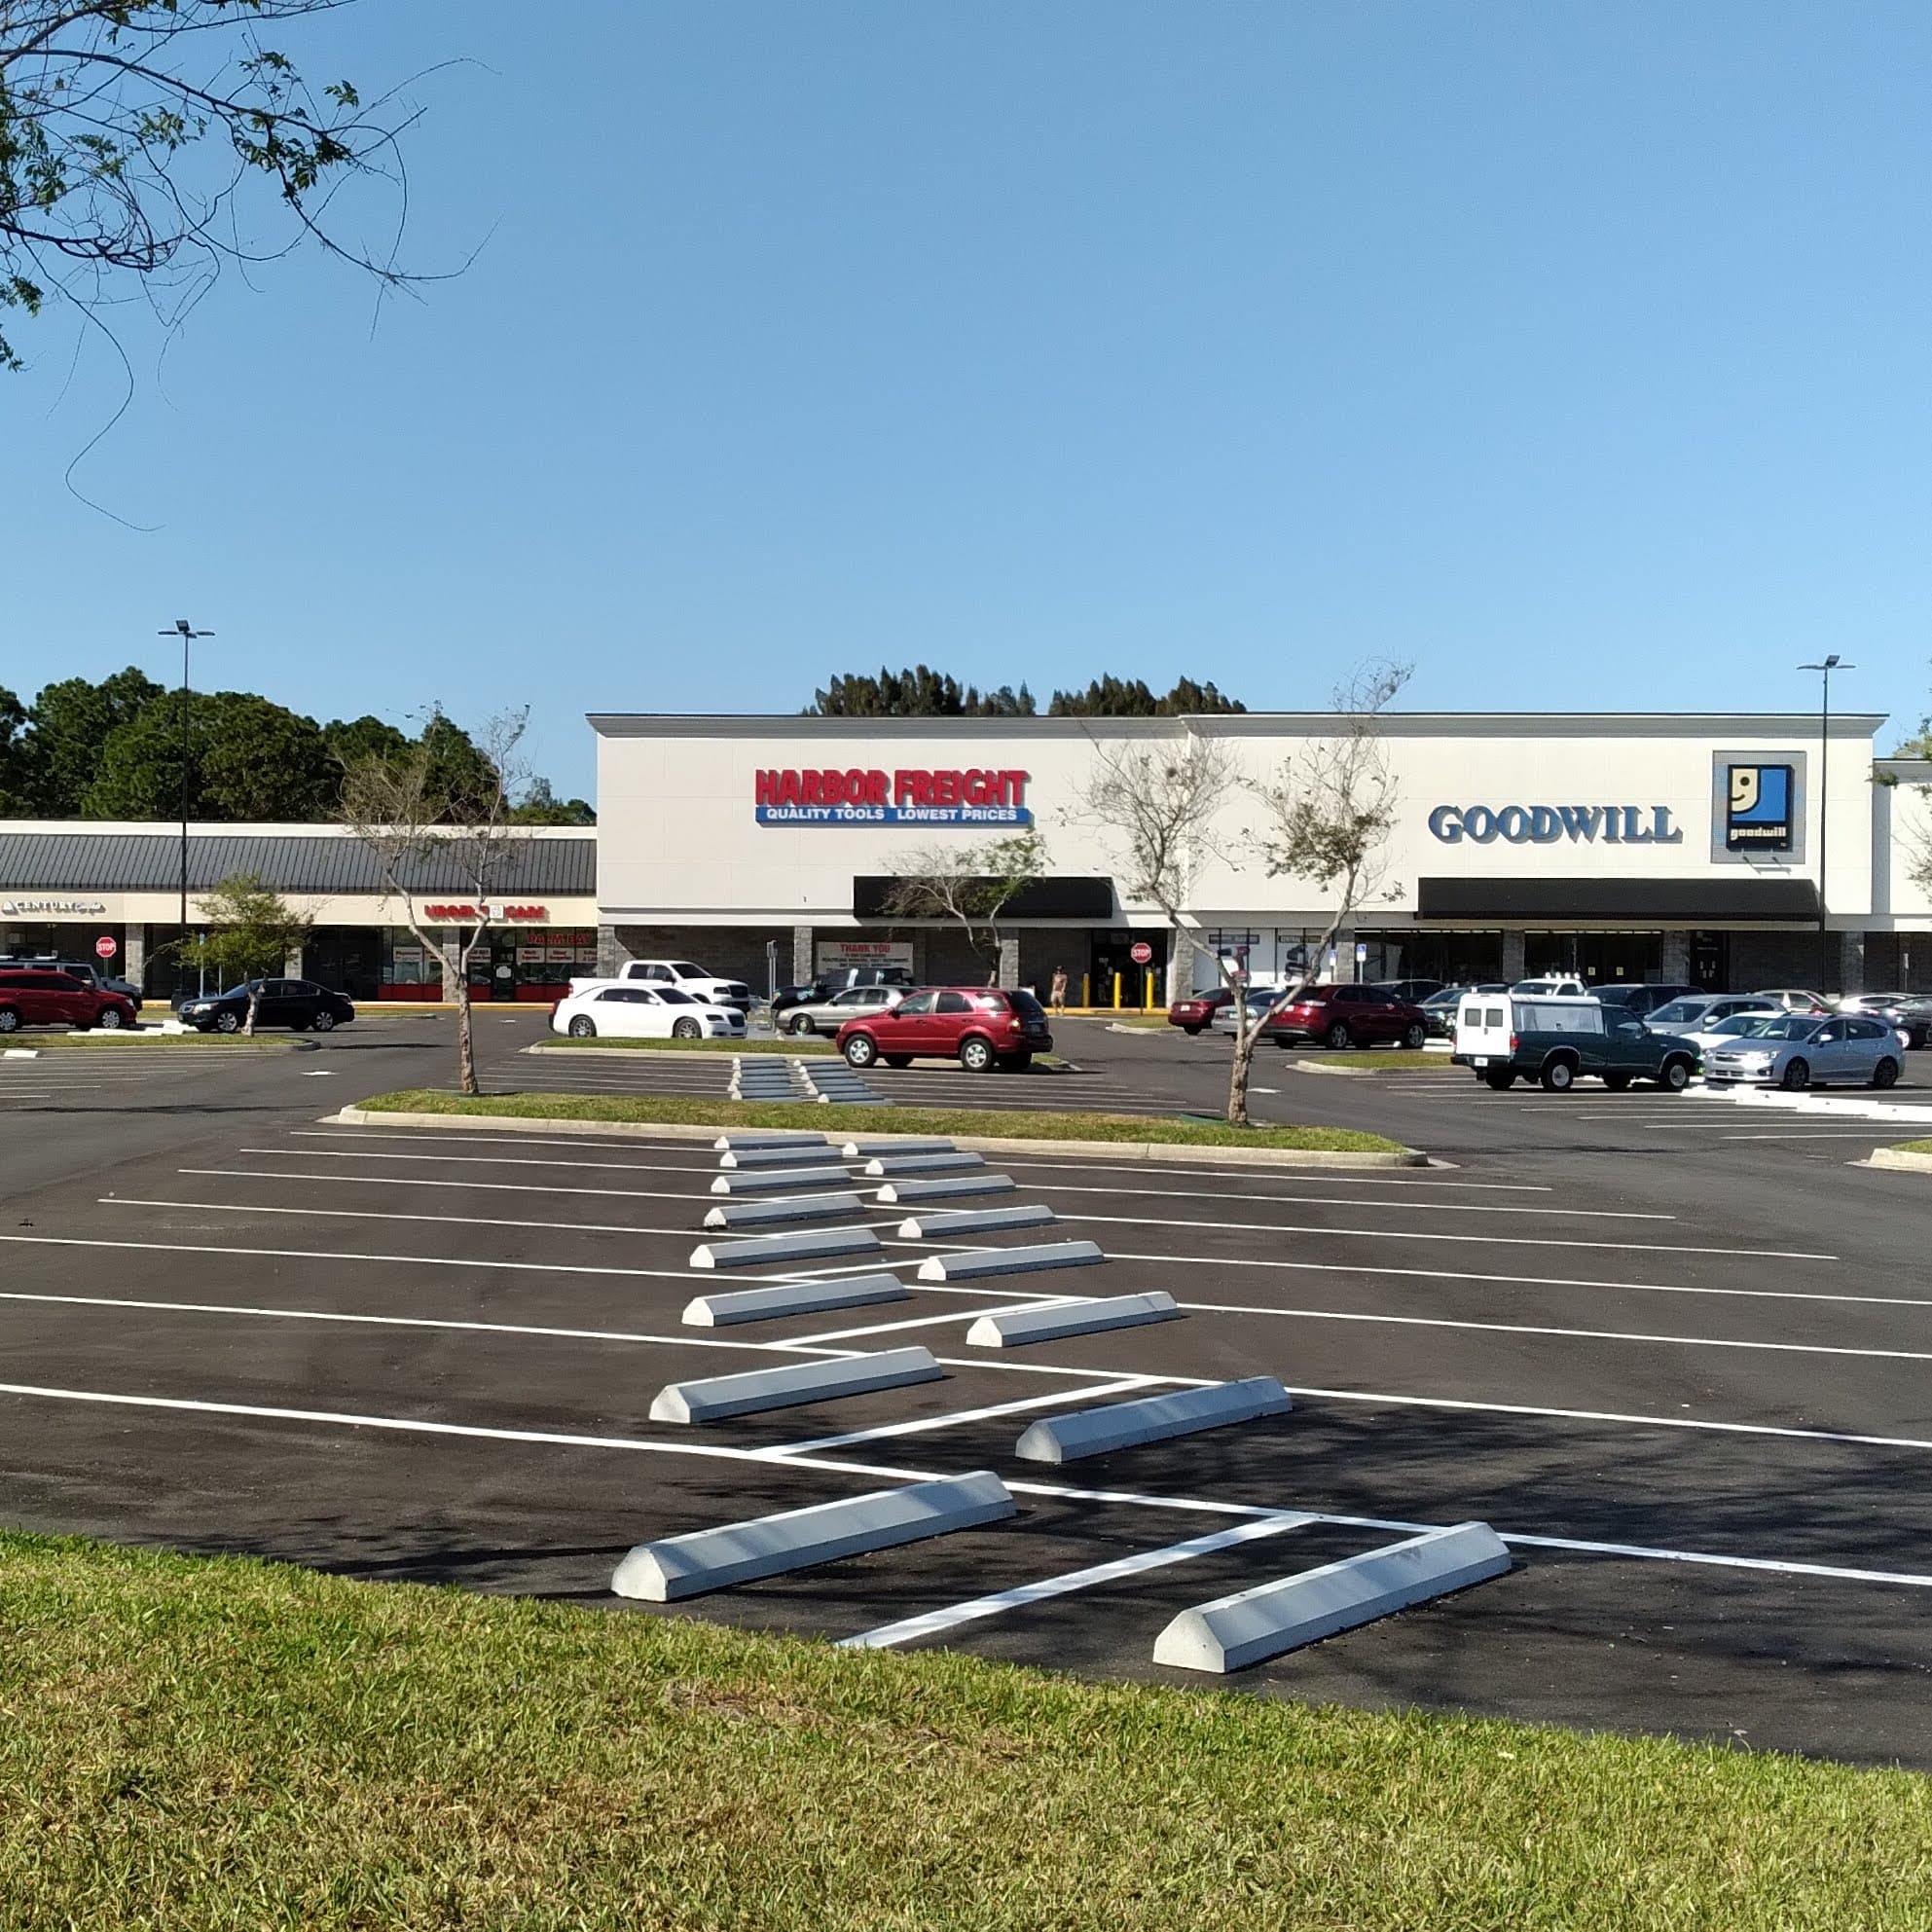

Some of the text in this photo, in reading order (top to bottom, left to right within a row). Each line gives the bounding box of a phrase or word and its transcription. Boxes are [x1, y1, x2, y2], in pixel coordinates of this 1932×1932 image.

[755, 768, 1027, 807] HARBOR FREIGHT
[766, 809, 1017, 820] QUALITY TOOLS LOWEST PRICES
[1428, 805, 1682, 844] GOODWILL
[1730, 826, 1787, 841] goodwill
[17, 900, 74, 911] CENTURY
[504, 905, 547, 920] CARE
[527, 933, 592, 945] PALM BAY
[97, 942, 115, 951] STOP
[840, 943, 891, 953] THANK YOU
[1132, 948, 1150, 958] STOP
